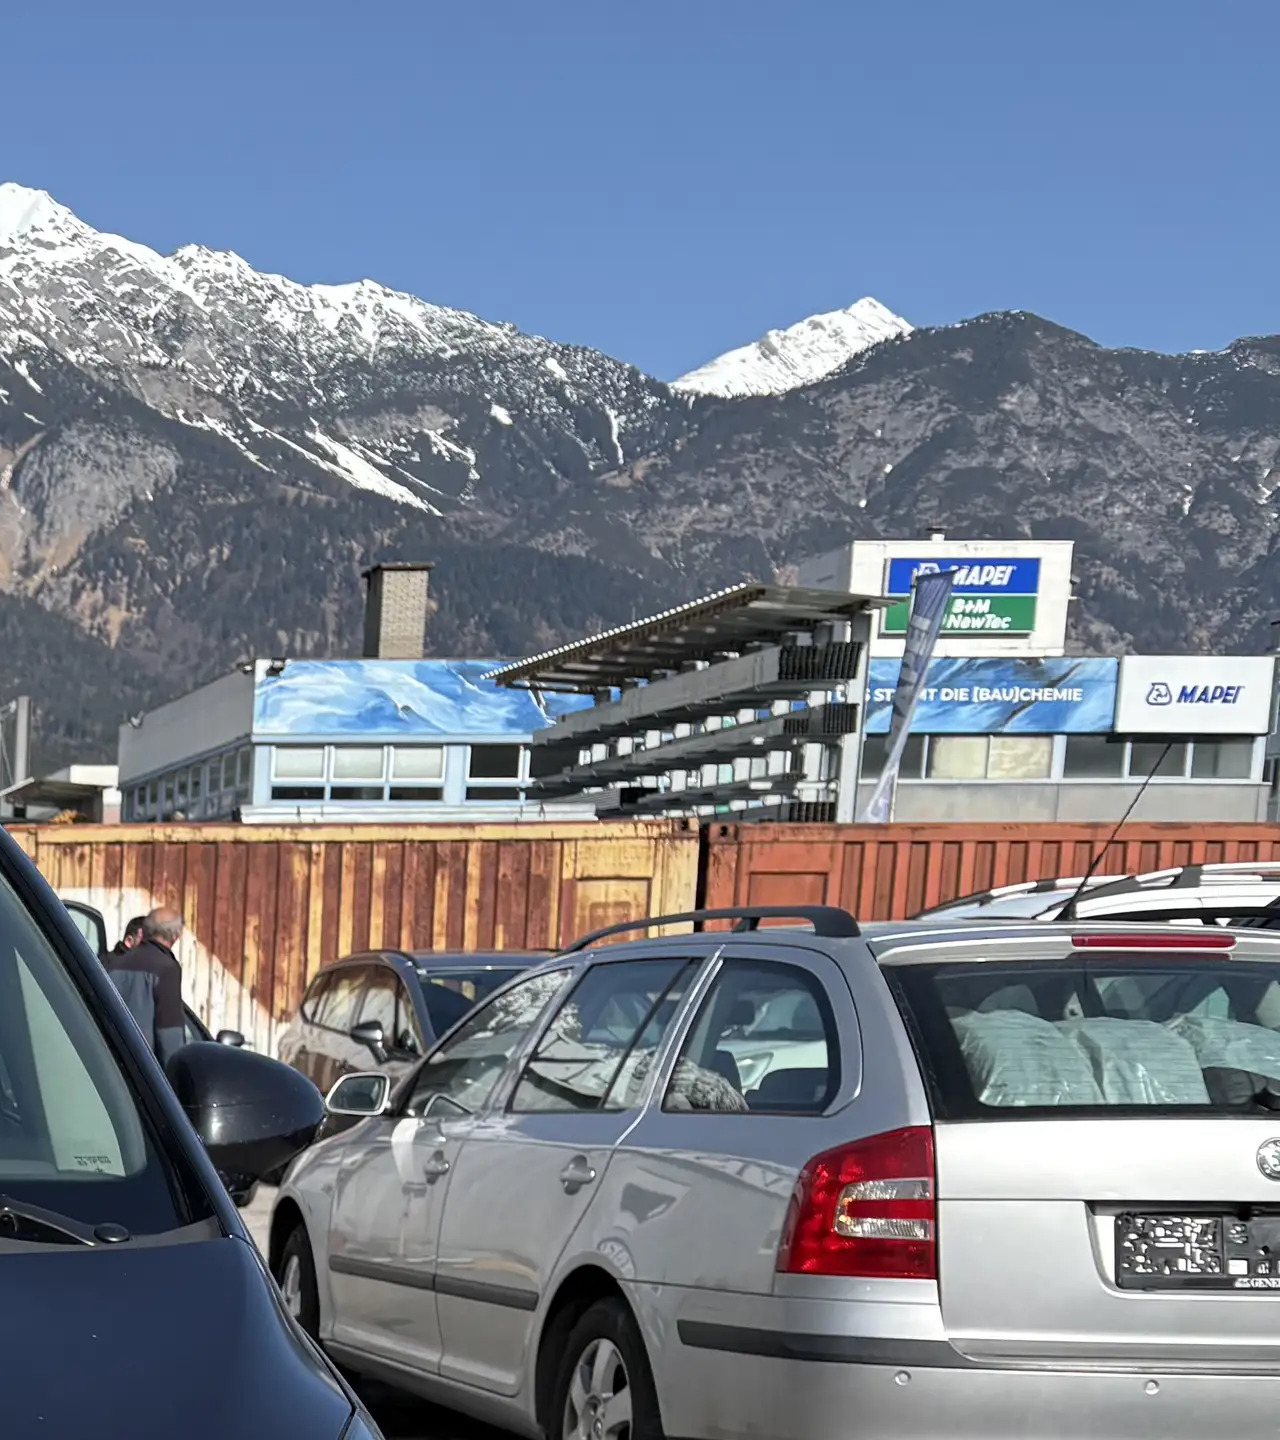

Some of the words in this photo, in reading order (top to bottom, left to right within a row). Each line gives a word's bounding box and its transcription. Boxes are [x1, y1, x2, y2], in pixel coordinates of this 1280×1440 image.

[950, 565, 1013, 585] MAPEI
[947, 614, 1011, 629] NewTec
[941, 688, 968, 701] DIE
[1176, 685, 1241, 705] MAPEI
